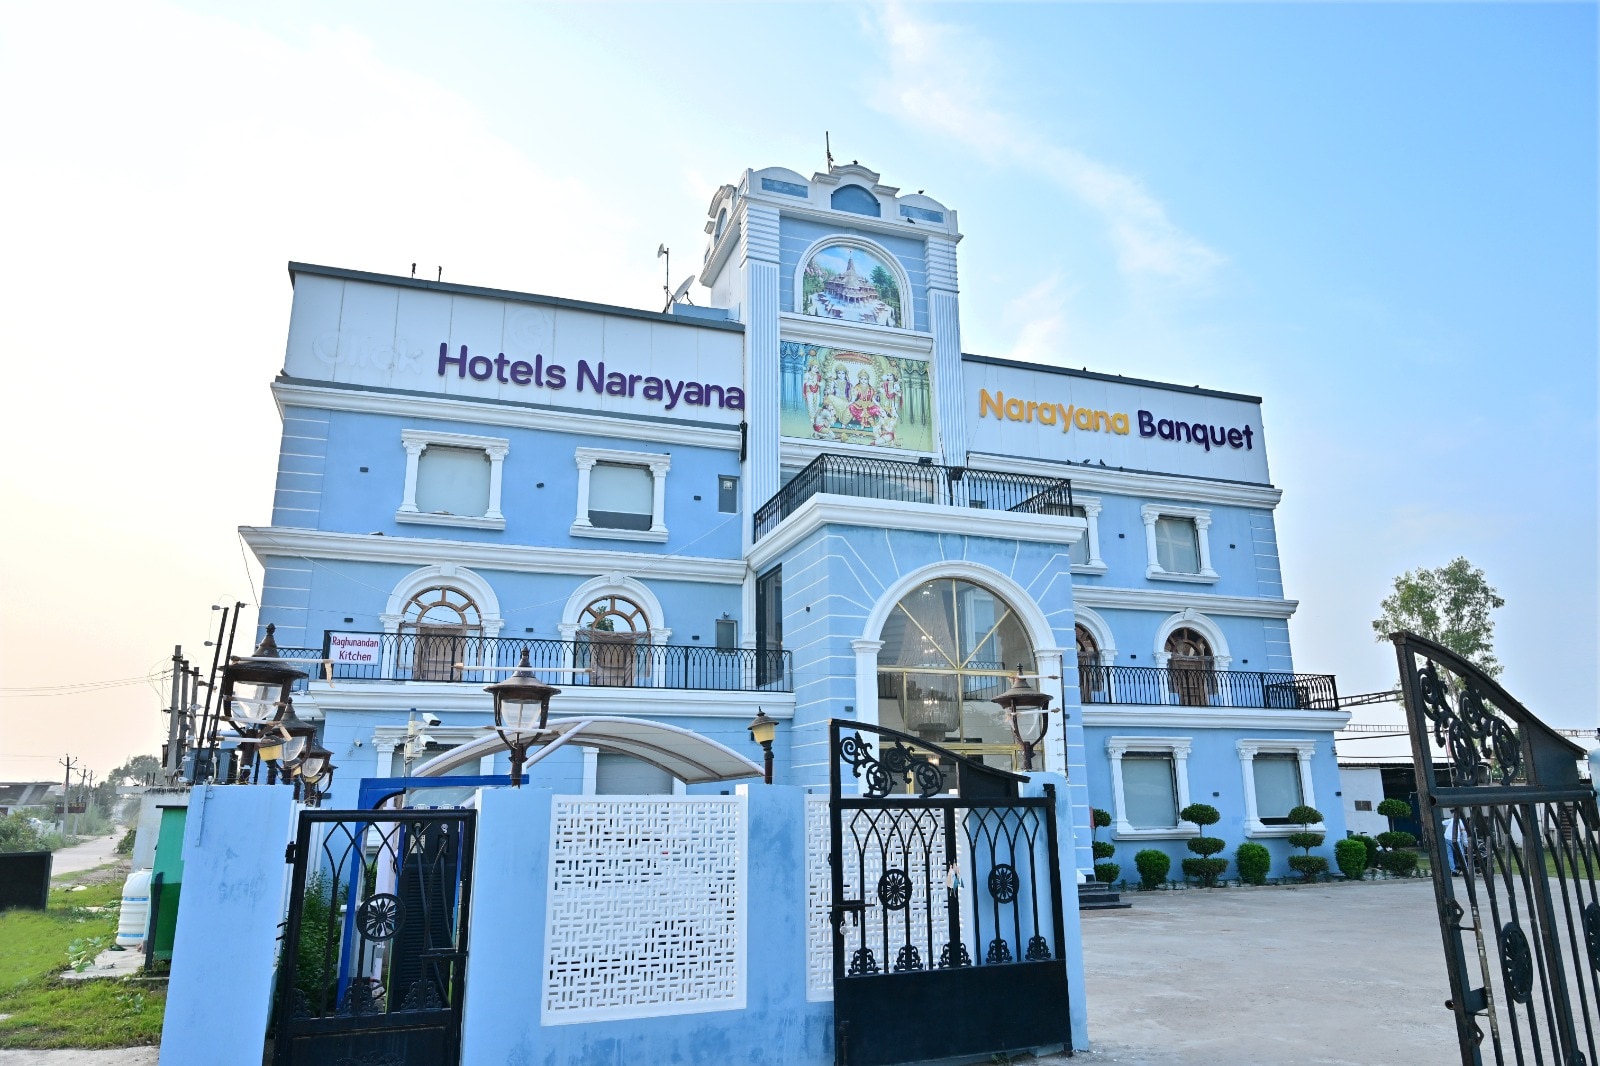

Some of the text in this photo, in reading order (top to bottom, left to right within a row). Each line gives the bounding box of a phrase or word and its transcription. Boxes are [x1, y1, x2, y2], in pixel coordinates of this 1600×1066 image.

[437, 342, 745, 410] Hotels Narayana
[979, 388, 1254, 451] Narayana Banquet
[332, 636, 379, 648] Raghunandan
[339, 650, 371, 661] Kitchen
